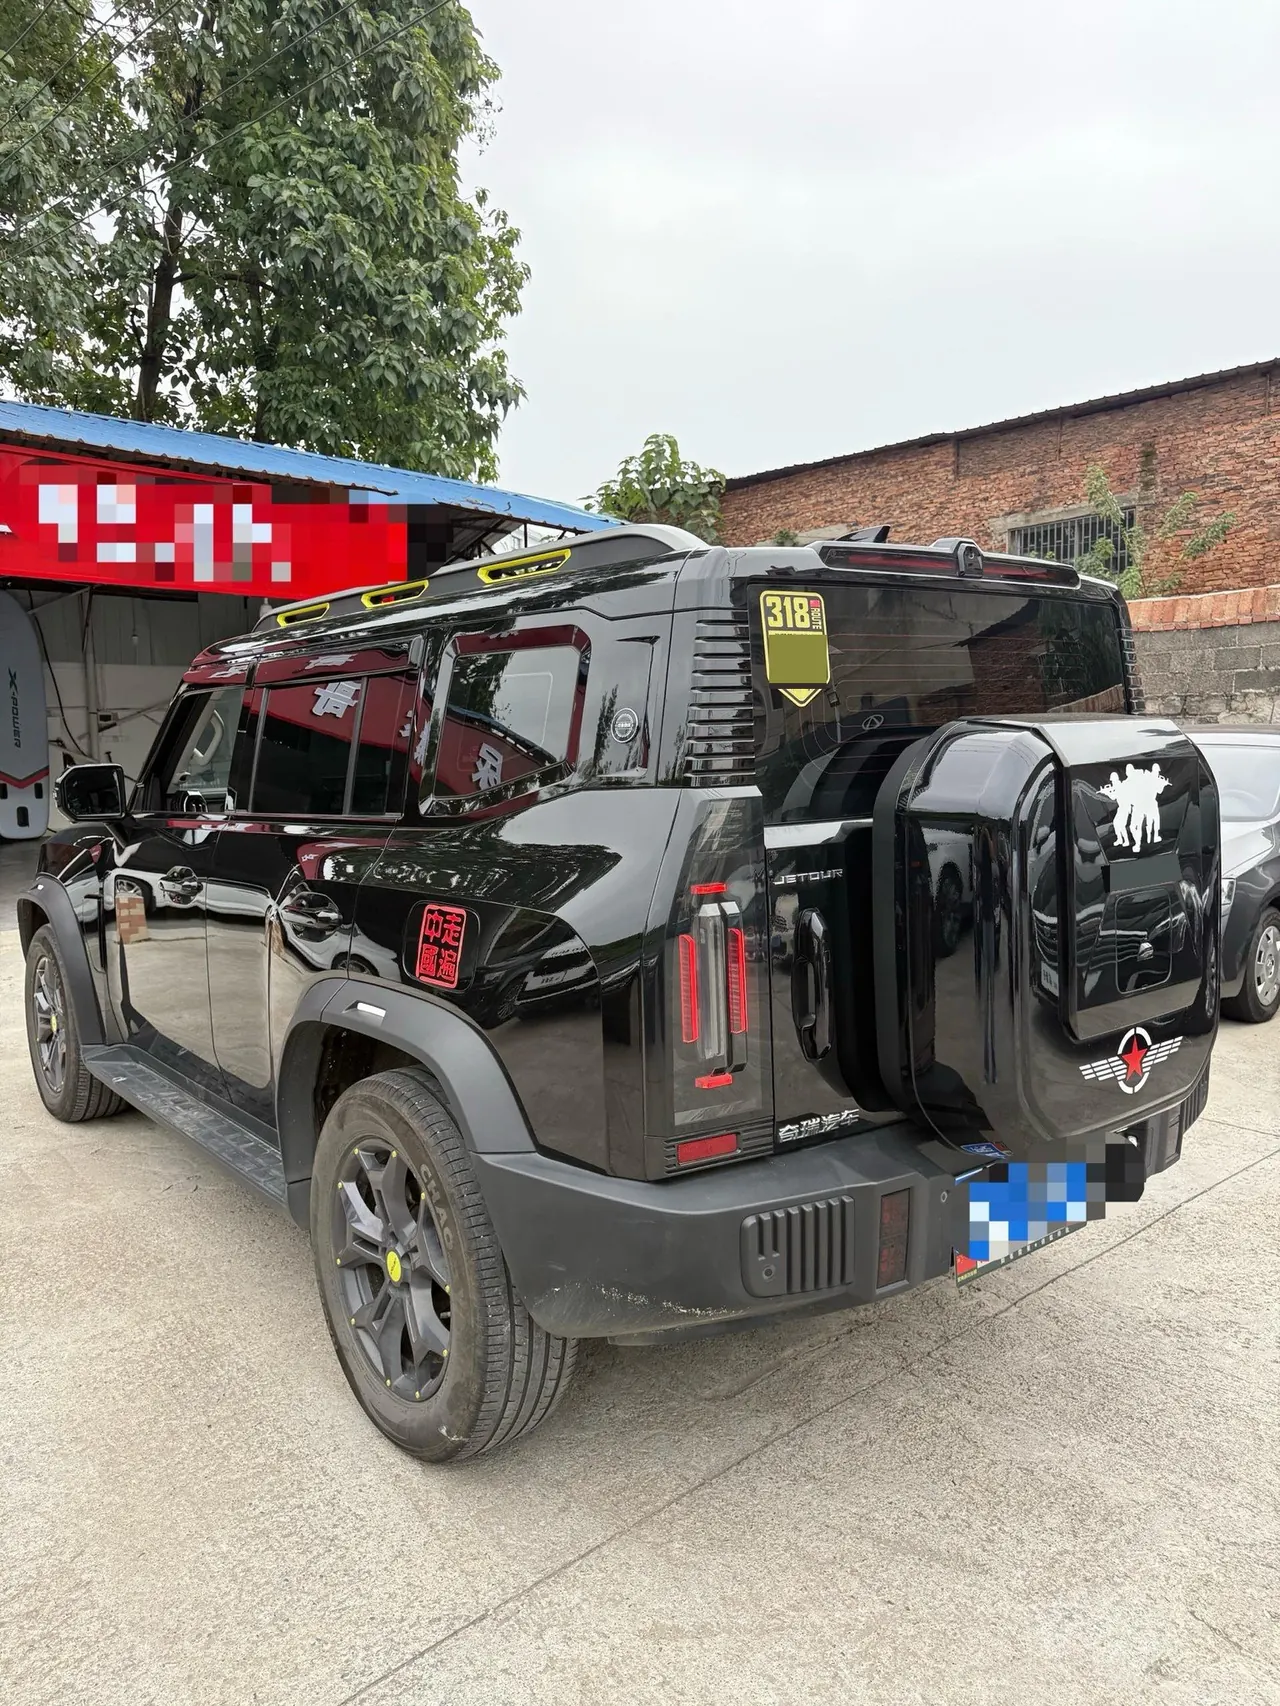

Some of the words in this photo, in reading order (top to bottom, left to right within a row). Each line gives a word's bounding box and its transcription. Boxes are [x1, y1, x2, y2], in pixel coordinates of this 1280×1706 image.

[766, 596, 811, 629] 318
[810, 607, 823, 630] ROUTE
[8, 667, 22, 749] X-POWER
[773, 868, 844, 886] JETOUR
[778, 1108, 860, 1144] 奇瑞汽车
